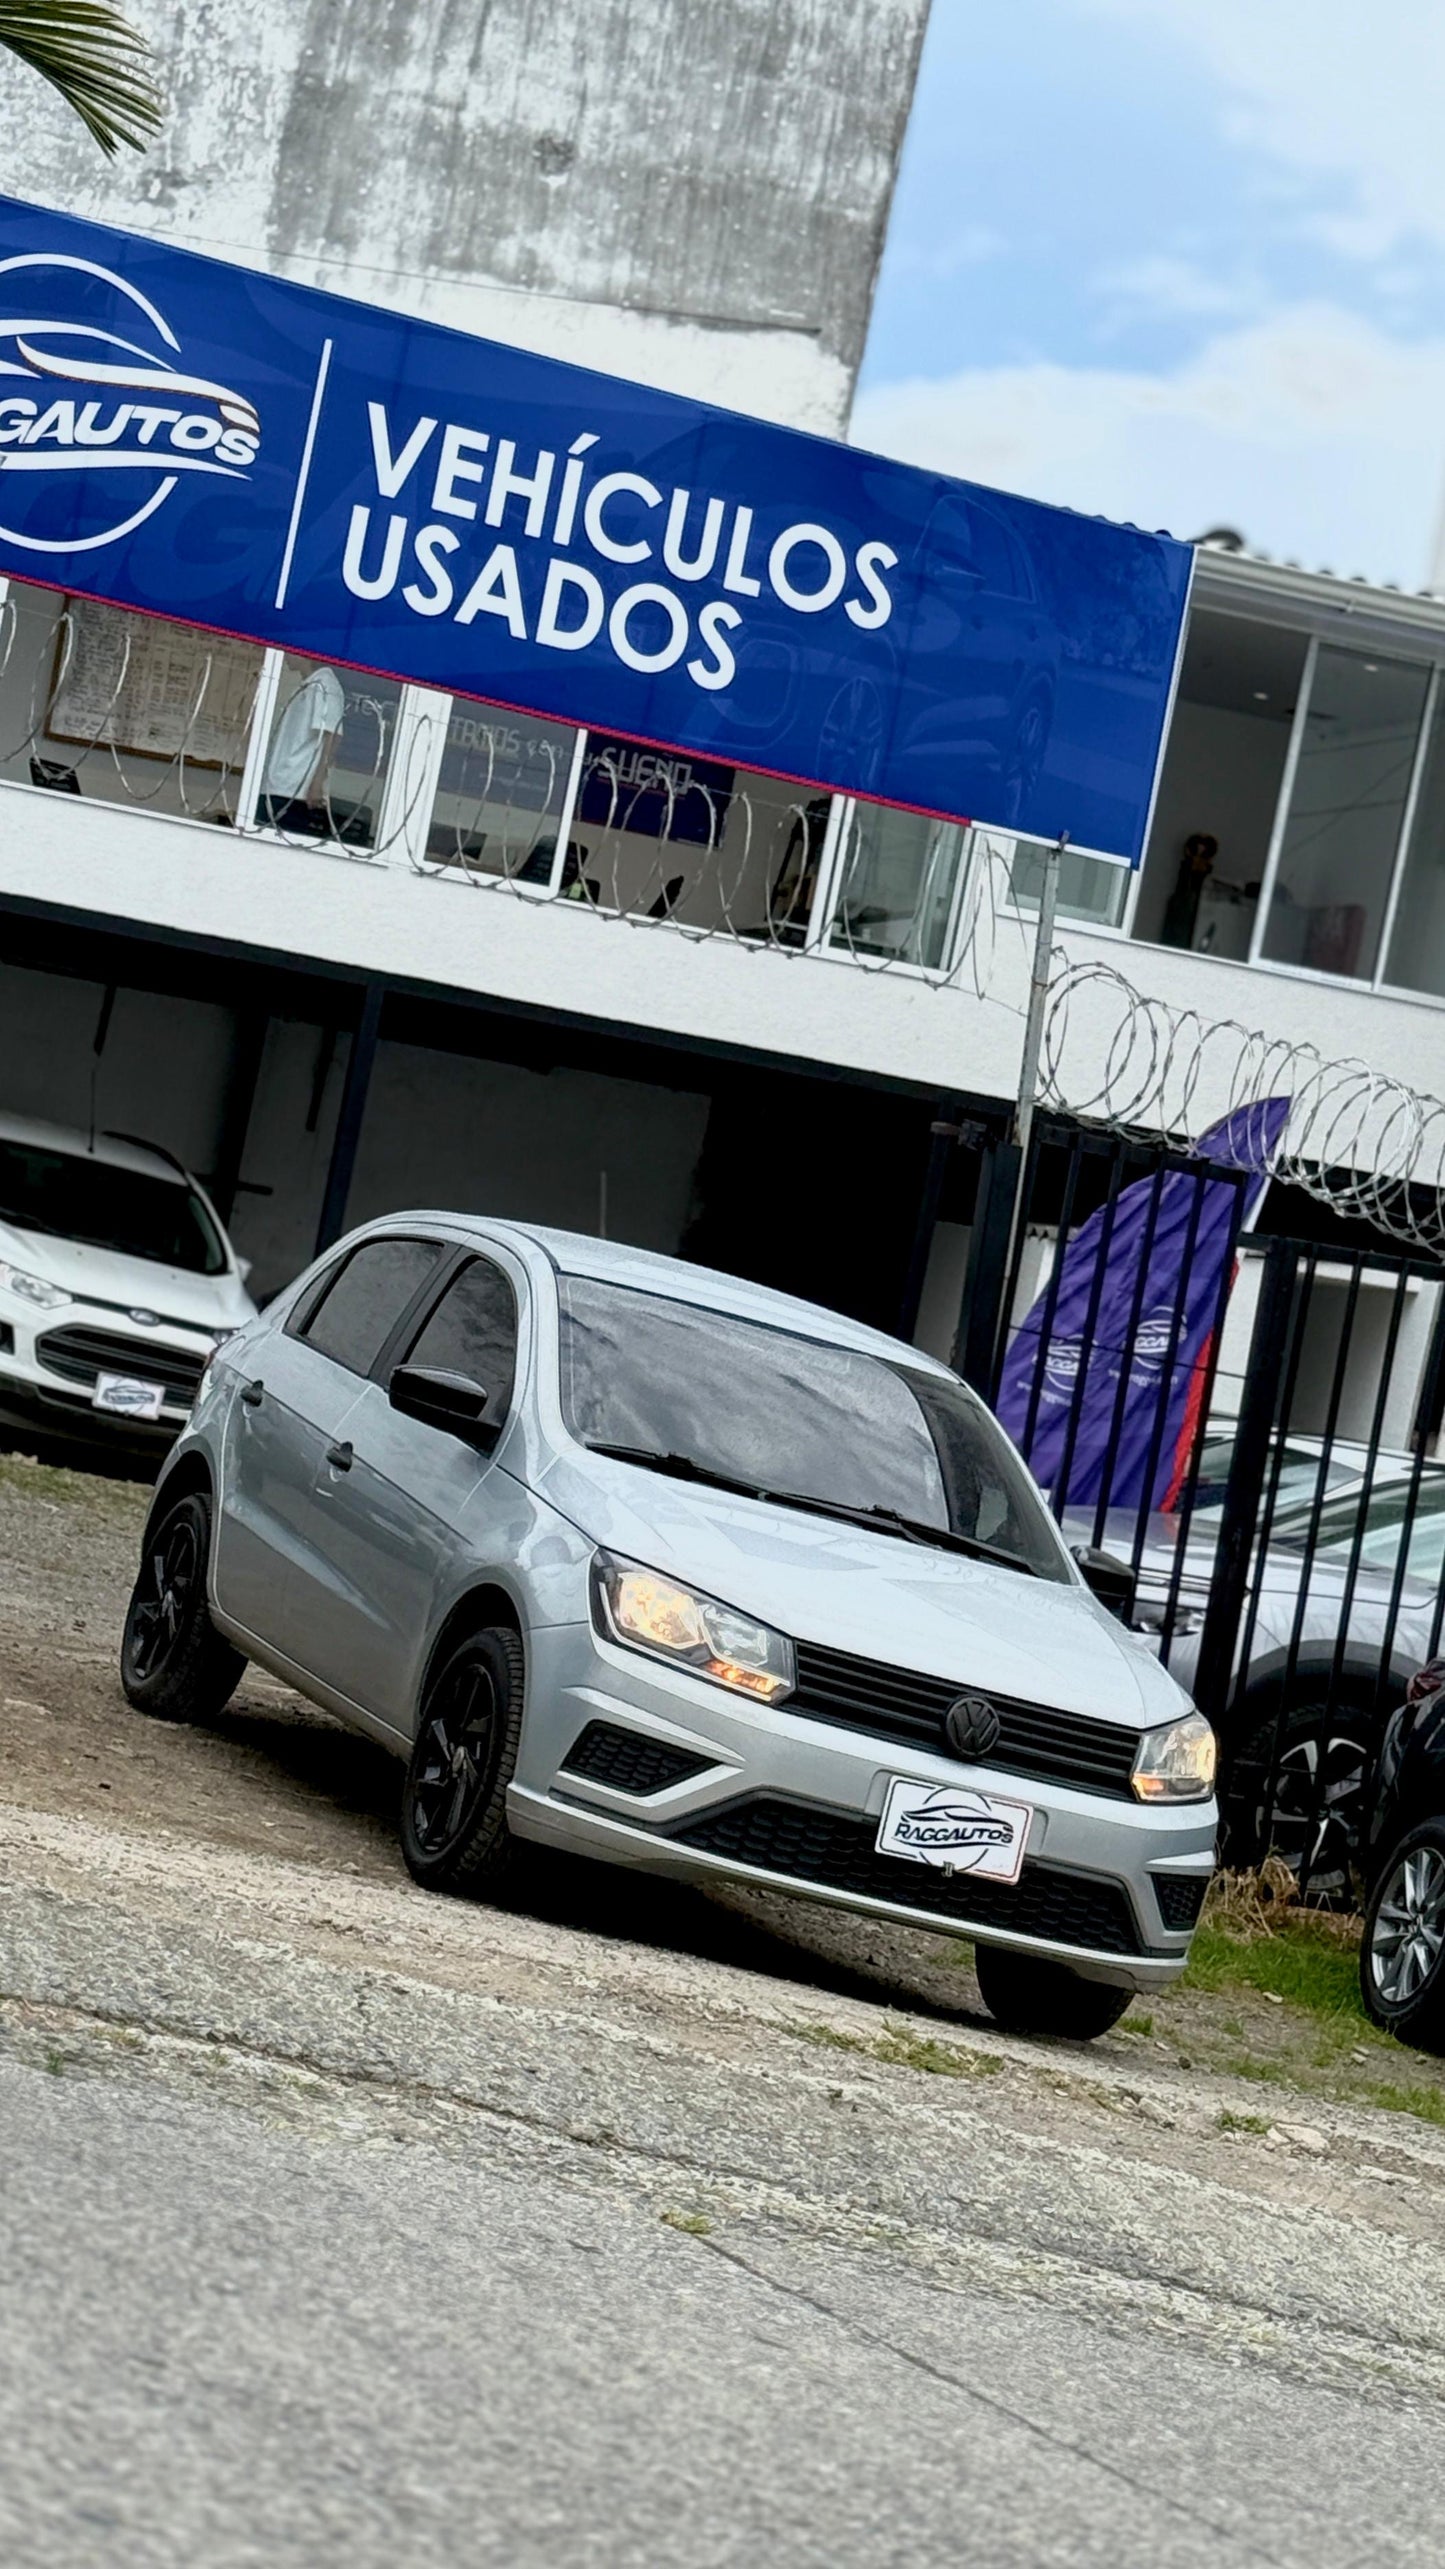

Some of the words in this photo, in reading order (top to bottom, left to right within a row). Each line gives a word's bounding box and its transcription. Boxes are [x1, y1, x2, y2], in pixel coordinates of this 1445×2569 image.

[342, 504, 743, 690] USADOS
[368, 401, 898, 630] VEHÍCULOS
[894, 1822, 1014, 1844] RAGGAUTOS
